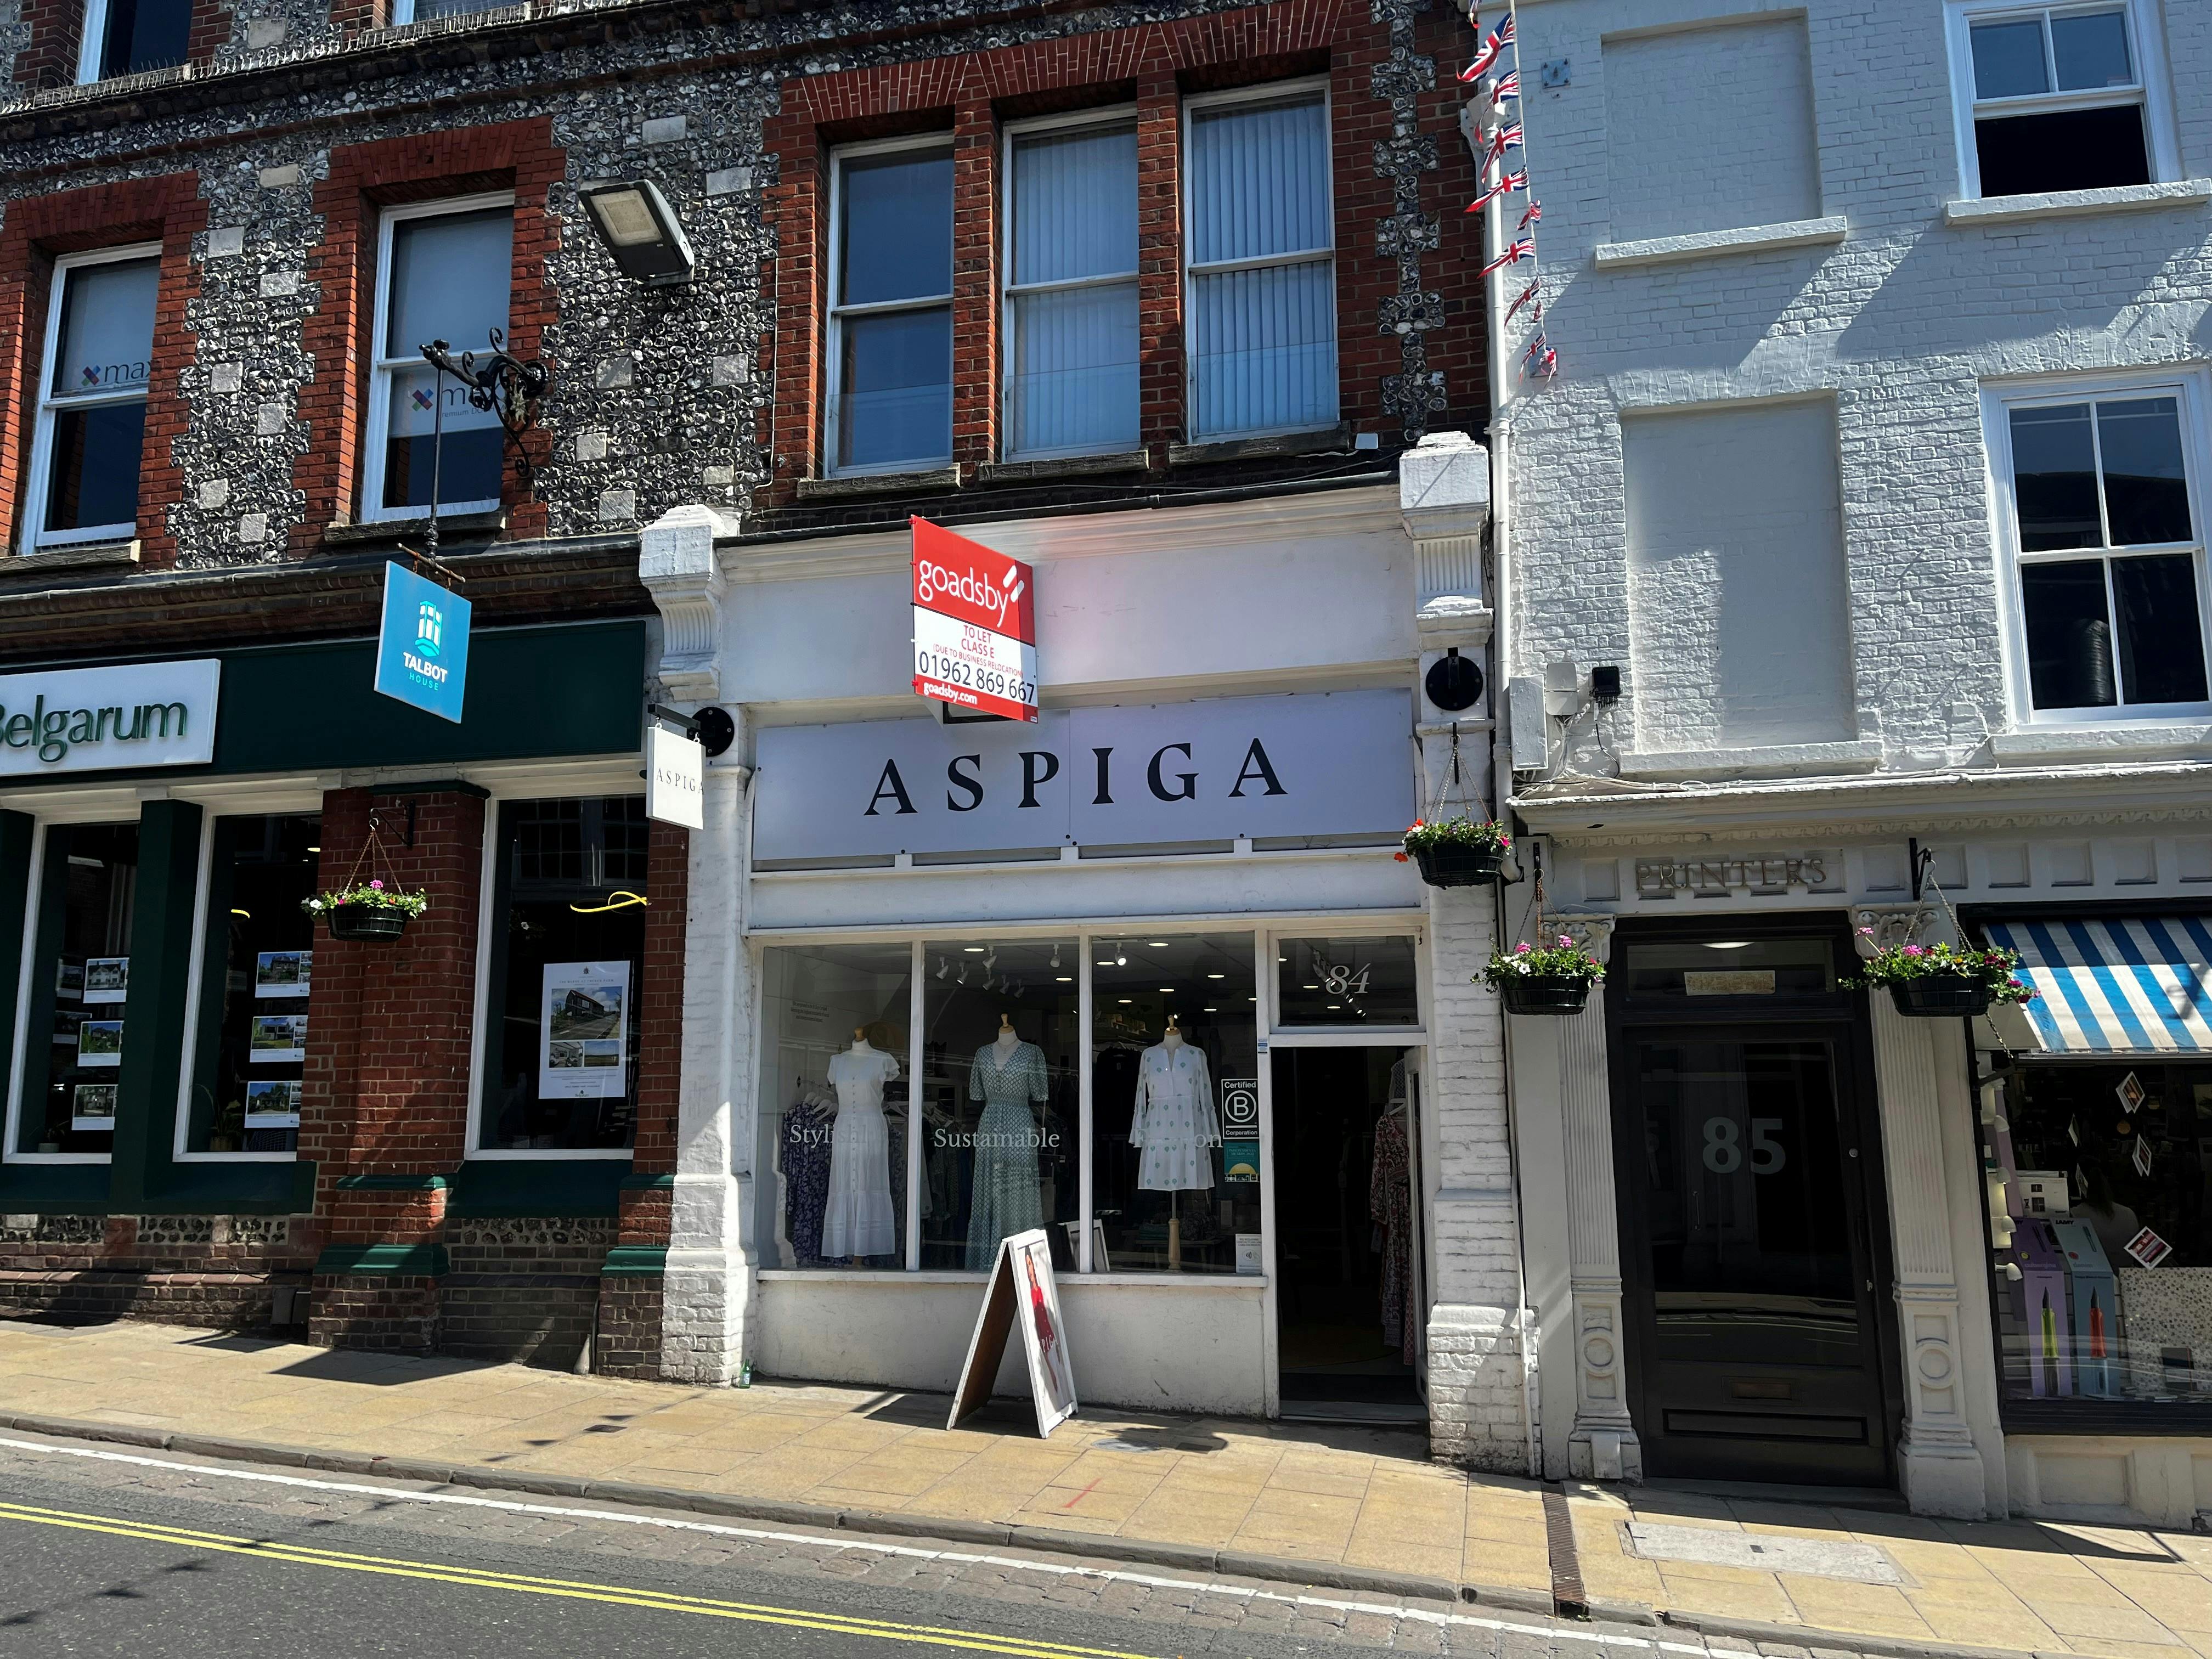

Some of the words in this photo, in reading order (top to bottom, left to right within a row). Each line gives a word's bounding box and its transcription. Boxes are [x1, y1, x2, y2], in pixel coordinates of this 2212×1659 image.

[442, 409, 469, 417] remium
[919, 560, 1009, 628] goadsby
[961, 638, 988, 656] CLASS
[990, 647, 995, 658] E
[963, 625, 975, 638] TO
[977, 629, 992, 644] LET
[403, 652, 448, 683] TALBOT
[919, 651, 971, 687] 01962
[976, 668, 1005, 695] 869
[1008, 678, 1035, 703] 667
[933, 644, 949, 655] (DUE
[950, 648, 957, 658] TO
[959, 651, 986, 667] BUSINESS
[988, 660, 1023, 679] RELOCATION)
[409, 672, 439, 691] HOUSE
[923, 682, 978, 705] goadsby.com
[0, 694, 188, 763] elgarum
[656, 768, 705, 795] ASPIGA
[863, 737, 1289, 816] ASPIGA
[1635, 857, 1827, 891] PRINTERS
[1325, 962, 1371, 995] 84
[1233, 1097, 1250, 1116] B
[934, 1127, 1060, 1148] Sustainable
[1702, 1116, 1787, 1175] 85
